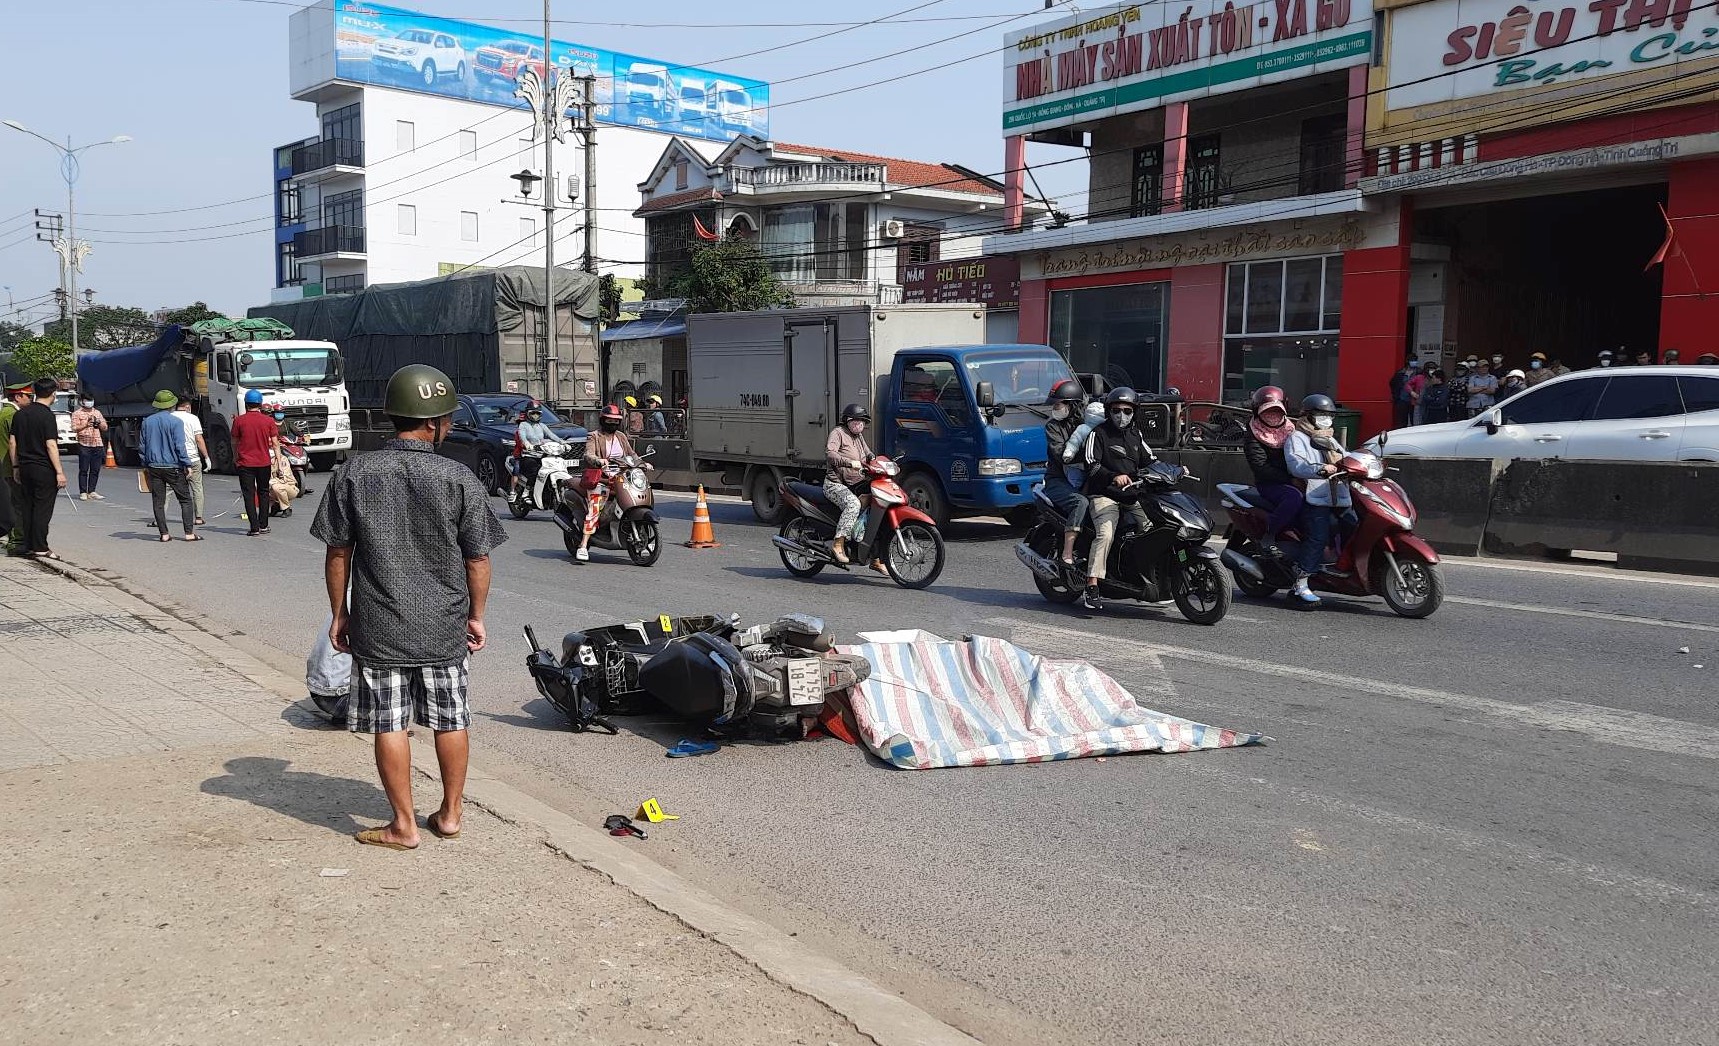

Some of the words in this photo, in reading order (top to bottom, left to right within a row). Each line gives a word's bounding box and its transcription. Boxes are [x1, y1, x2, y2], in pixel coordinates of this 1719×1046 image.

[1016, 49, 1054, 101] NHÀ
[1057, 40, 1099, 92] MÁY
[1101, 25, 1143, 81] SẢN
[1146, 6, 1203, 71] XUẤT
[1209, 0, 1253, 57] TÔN
[1443, 5, 1576, 66] SIÊU
[1589, 0, 1692, 37] THỊ
[1493, 60, 1613, 87] Bạn
[791, 667, 806, 699] 74-B1
[805, 662, 822, 702] 25441
[650, 803, 657, 815] 4
